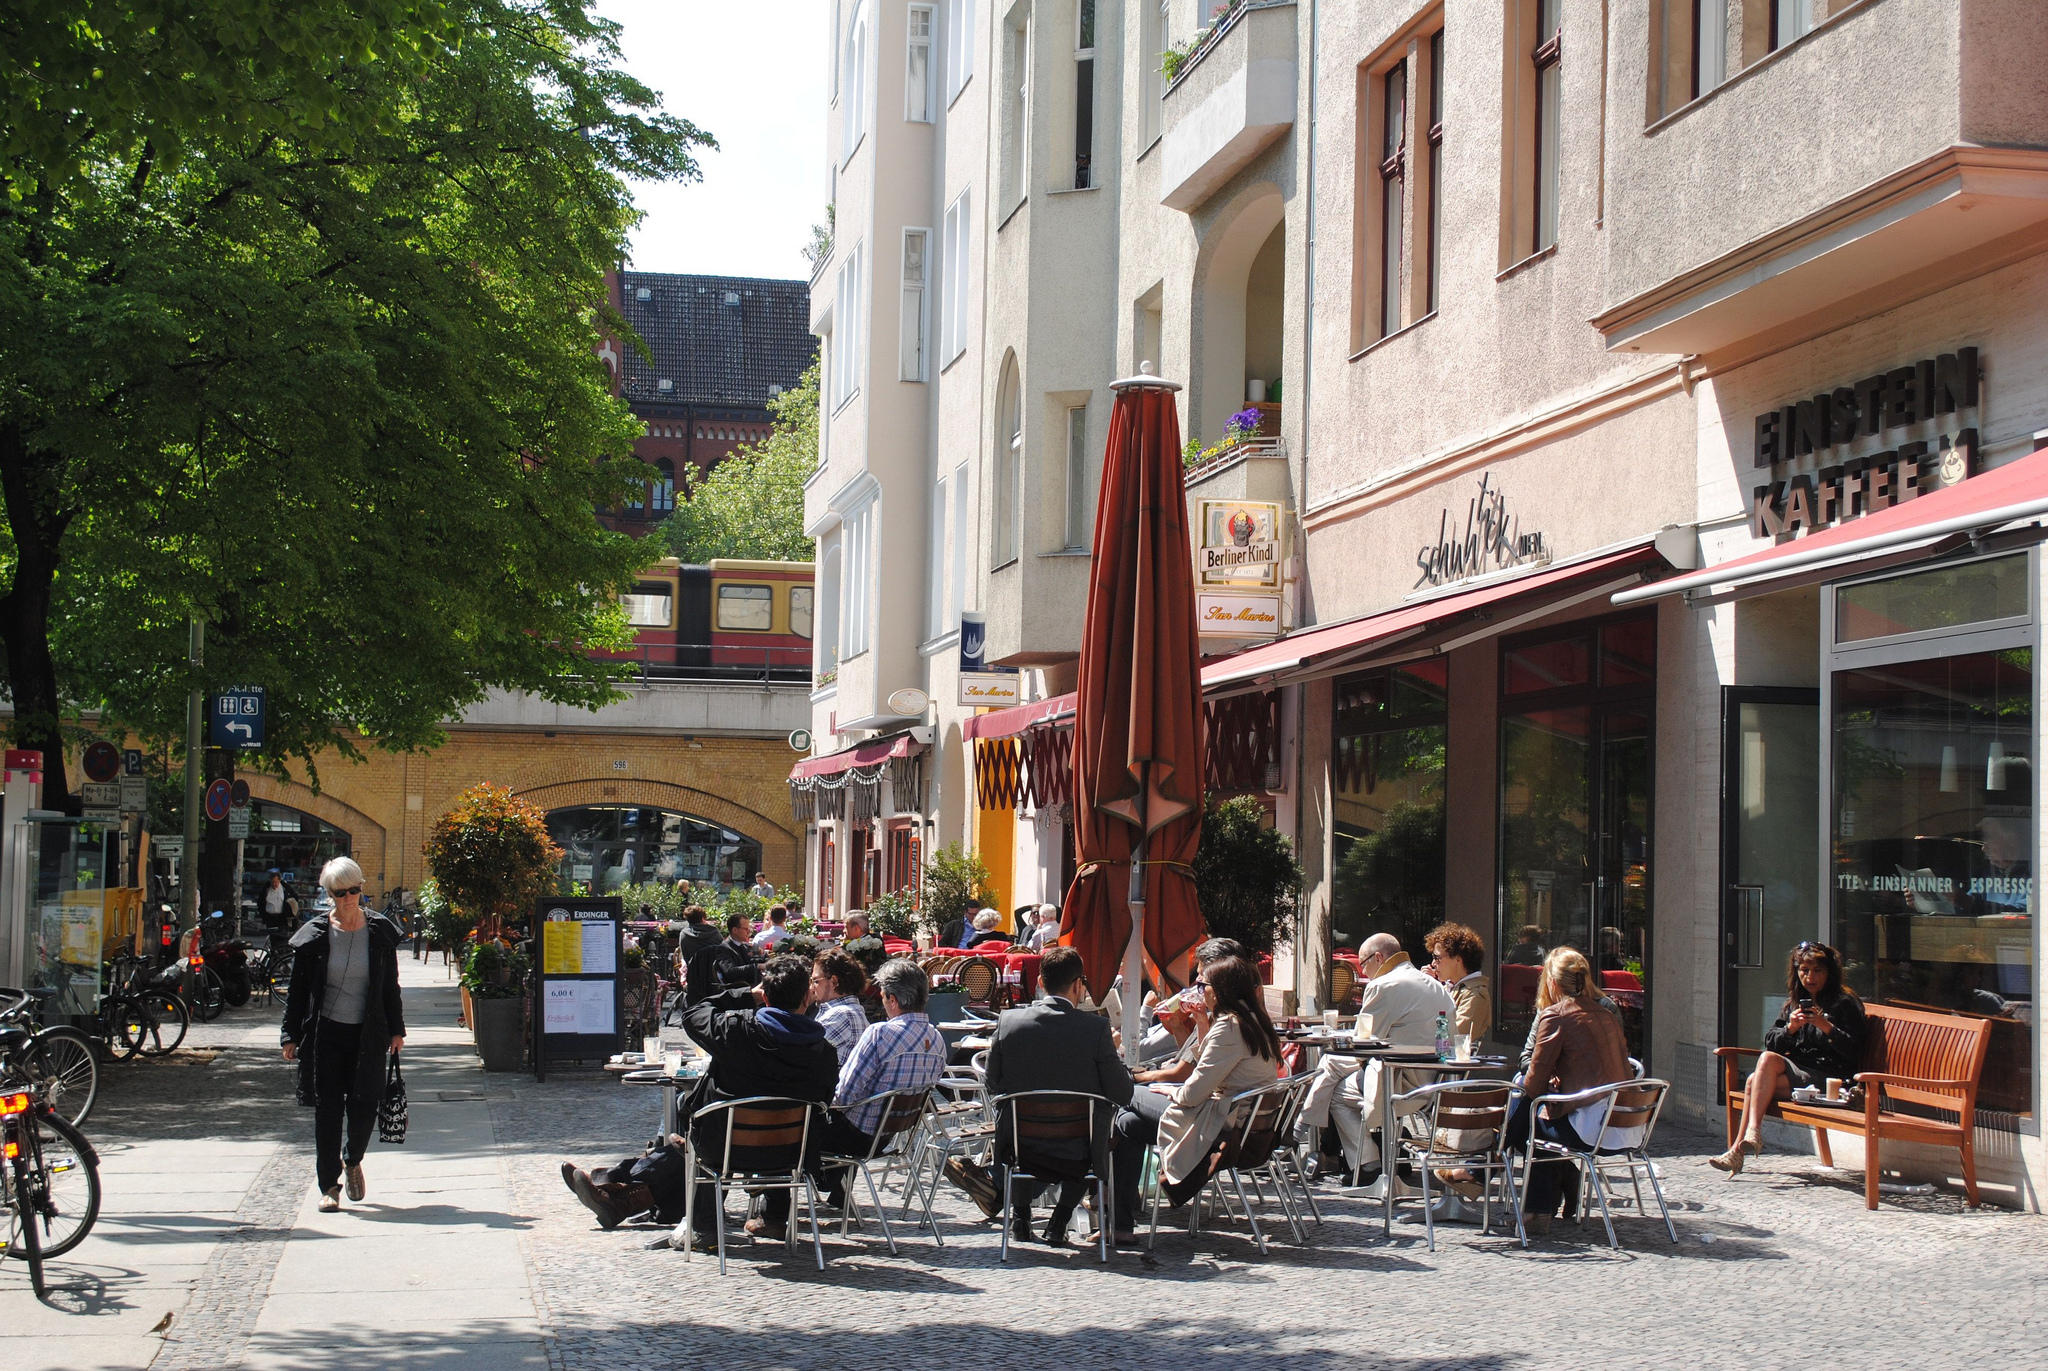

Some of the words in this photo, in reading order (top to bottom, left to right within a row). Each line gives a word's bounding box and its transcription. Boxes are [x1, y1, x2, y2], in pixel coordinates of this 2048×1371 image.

[1754, 346, 1979, 469] EINSTEIN
[1753, 440, 1929, 540] KAFFEE
[1208, 549, 1246, 568] Berliner
[1248, 544, 1273, 562] Kindl
[1204, 606, 1232, 621] San
[1234, 607, 1275, 622] Marino
[964, 685, 985, 696] San
[984, 686, 1015, 697] Marino
[613, 761, 627, 769] 596
[1873, 872, 1954, 893] EINSPÄNNER
[574, 911, 609, 919] ERDINGER
[551, 989, 568, 997] 6,00
[569, 989, 574, 997] €
